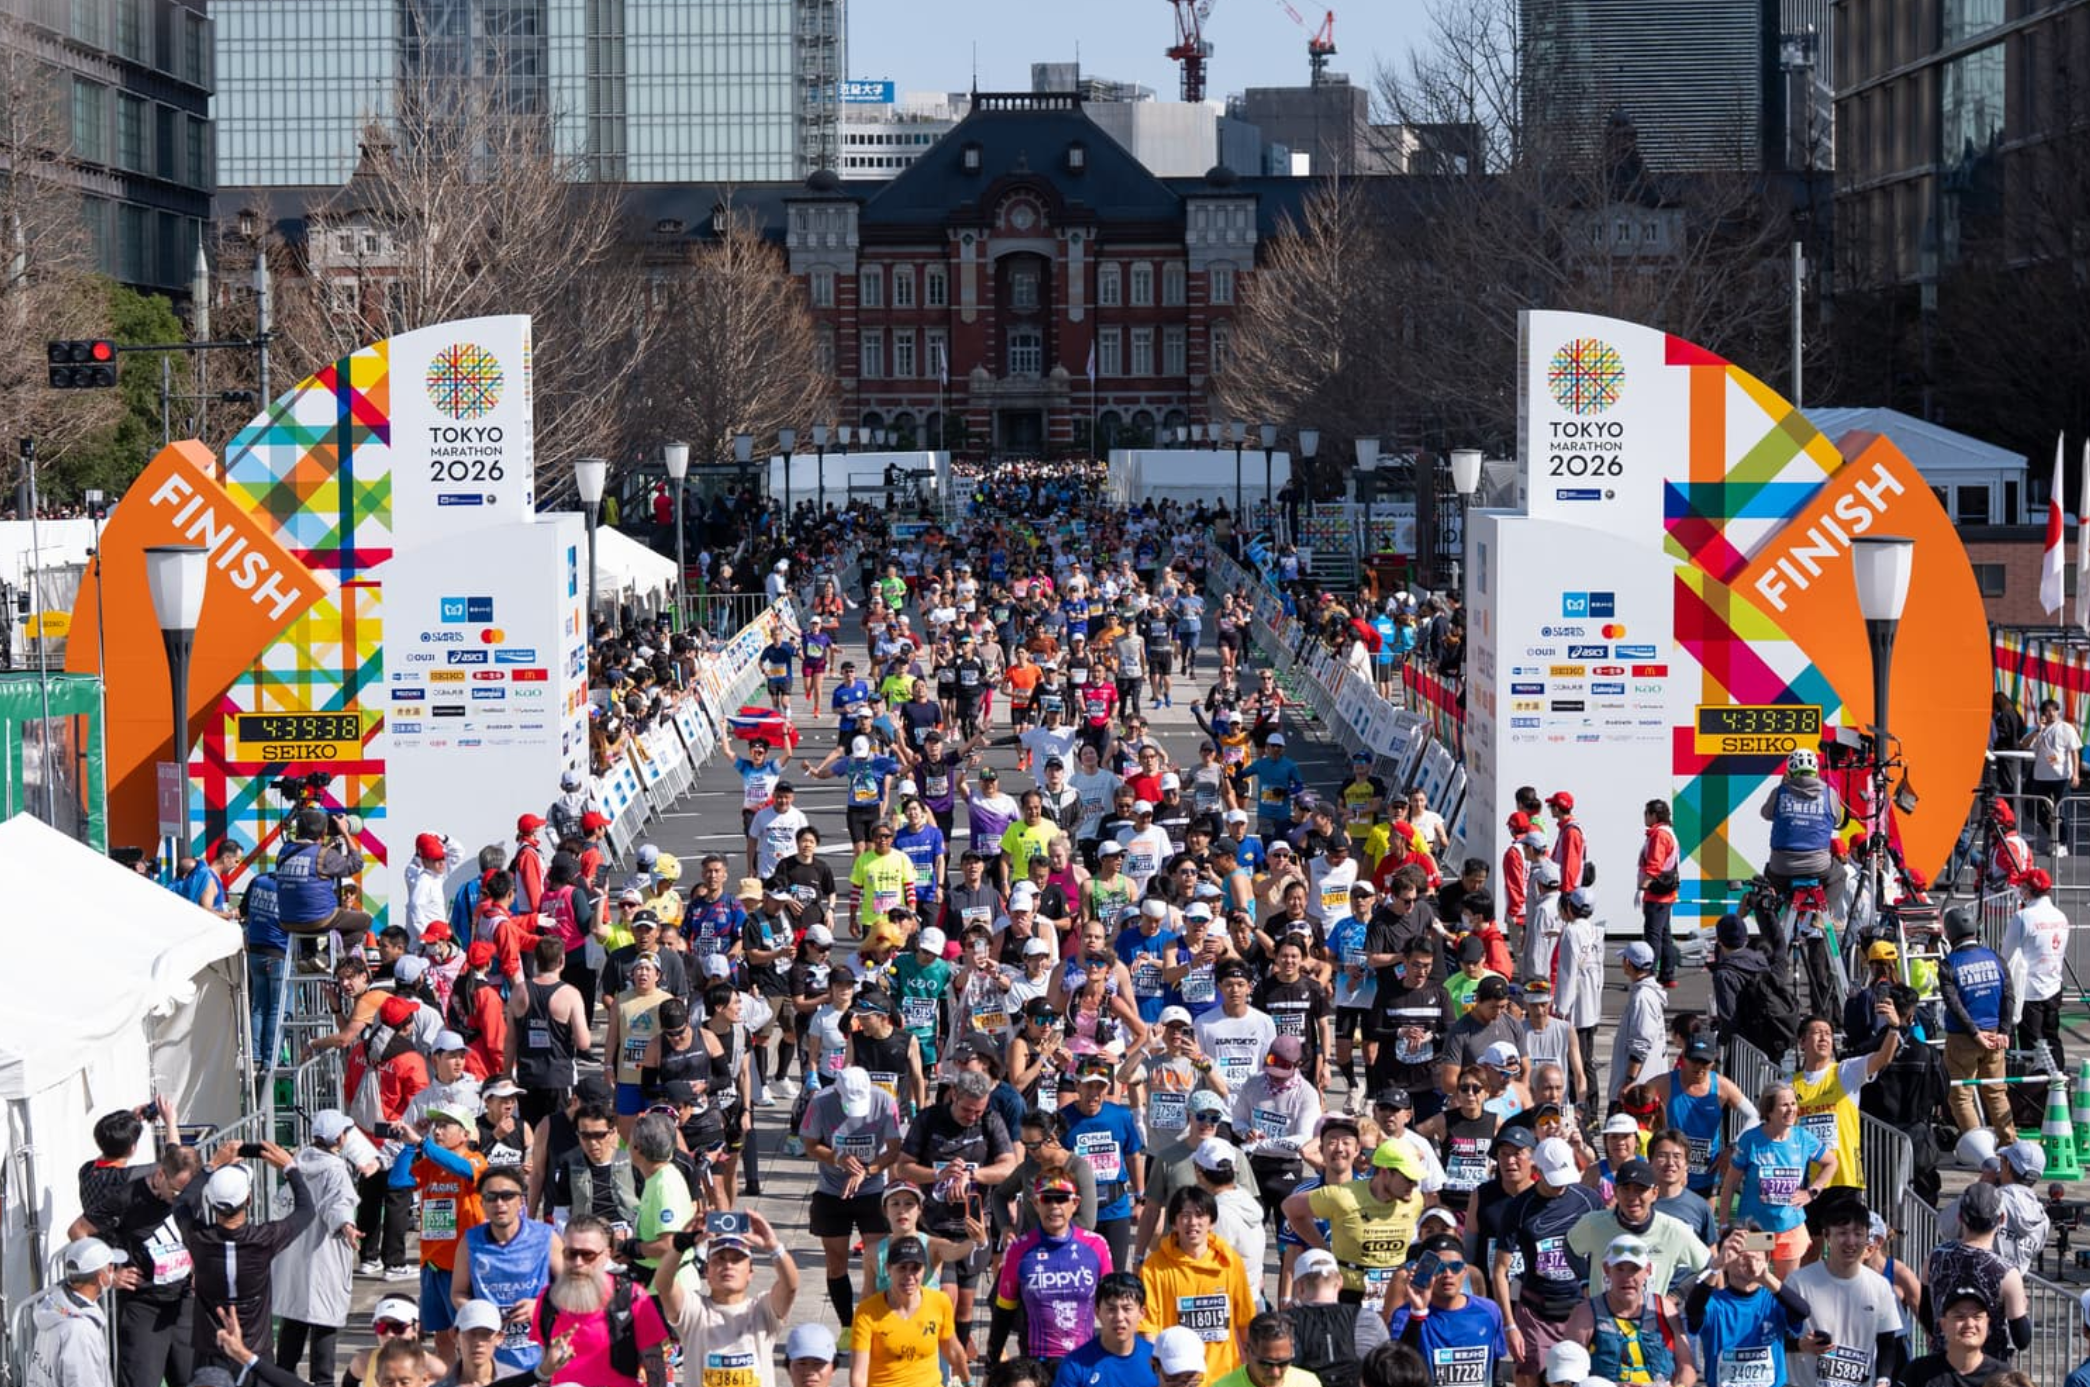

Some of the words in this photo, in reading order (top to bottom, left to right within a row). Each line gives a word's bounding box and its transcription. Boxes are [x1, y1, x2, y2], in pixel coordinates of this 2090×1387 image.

[429, 426, 503, 443] TOKYO
[1549, 421, 1624, 438] TOKYO
[430, 446, 503, 457] MARATHON
[1550, 441, 1623, 451] MARATHON
[430, 460, 504, 482] 2026
[1549, 455, 1624, 477] 2026
[1754, 462, 1905, 613] FINISH
[149, 472, 301, 622] FINISH
[262, 717, 357, 739] 4:39:38
[1722, 710, 1817, 732] 4:39:38
[262, 743, 338, 761] SEIKO
[1721, 736, 1798, 753] SEIKO
[1956, 959, 1998, 973] SPONSOR
[1959, 968, 2001, 986] CAMERA
[1768, 1180, 1797, 1193] 37237
[1547, 1251, 1568, 1266] 372
[1191, 1310, 1224, 1327] 18015
[1448, 1364, 1484, 1382] 17228
[1730, 1364, 1767, 1380] 34027
[1830, 1359, 1864, 1381] 15884
